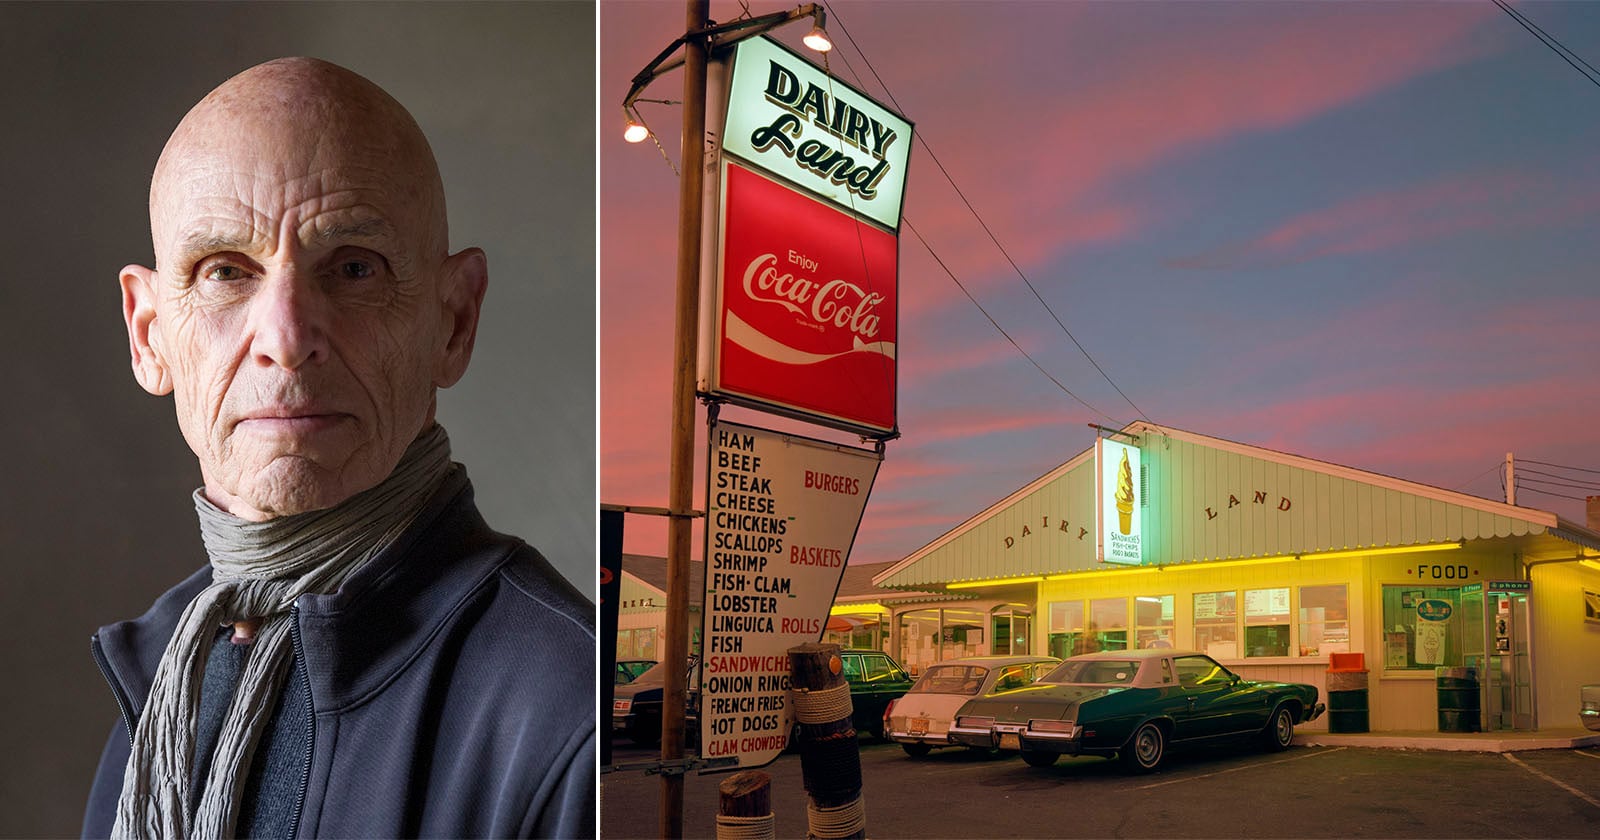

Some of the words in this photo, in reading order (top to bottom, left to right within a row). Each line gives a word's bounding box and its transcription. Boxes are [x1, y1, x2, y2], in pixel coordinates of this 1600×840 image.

[764, 60, 897, 161] DAIRY
[751, 115, 891, 200] Land
[788, 249, 819, 273] Enjoy
[742, 253, 885, 338] Coca-Cola
[719, 430, 755, 452] HAM
[718, 451, 761, 473] BEEF
[717, 471, 772, 495] STEAK
[804, 470, 860, 496] BURGERS
[716, 492, 775, 514] CHEESE
[716, 511, 787, 535] CHICKENS
[1004, 515, 1088, 549] DAIRY
[1205, 490, 1292, 521] LAND
[715, 532, 783, 553] SCALLOPS
[714, 552, 768, 573] SHRIMP
[790, 545, 841, 568] BASKETS
[1418, 565, 1469, 579] FOOD
[754, 575, 791, 594] CLAM
[713, 594, 777, 613] LOBSTER
[712, 616, 774, 633] LINGUICA
[781, 617, 820, 634] ROLLS
[711, 636, 743, 653] FISH
[709, 656, 792, 673] SANDWICHE
[708, 676, 752, 693] ONION
[711, 697, 754, 714] FRENCH
[758, 696, 785, 711] FRIES
[711, 718, 736, 735] HOT
[742, 715, 778, 732] DOGS
[708, 739, 738, 756] CLAM
[741, 735, 786, 752] CHOWDER
